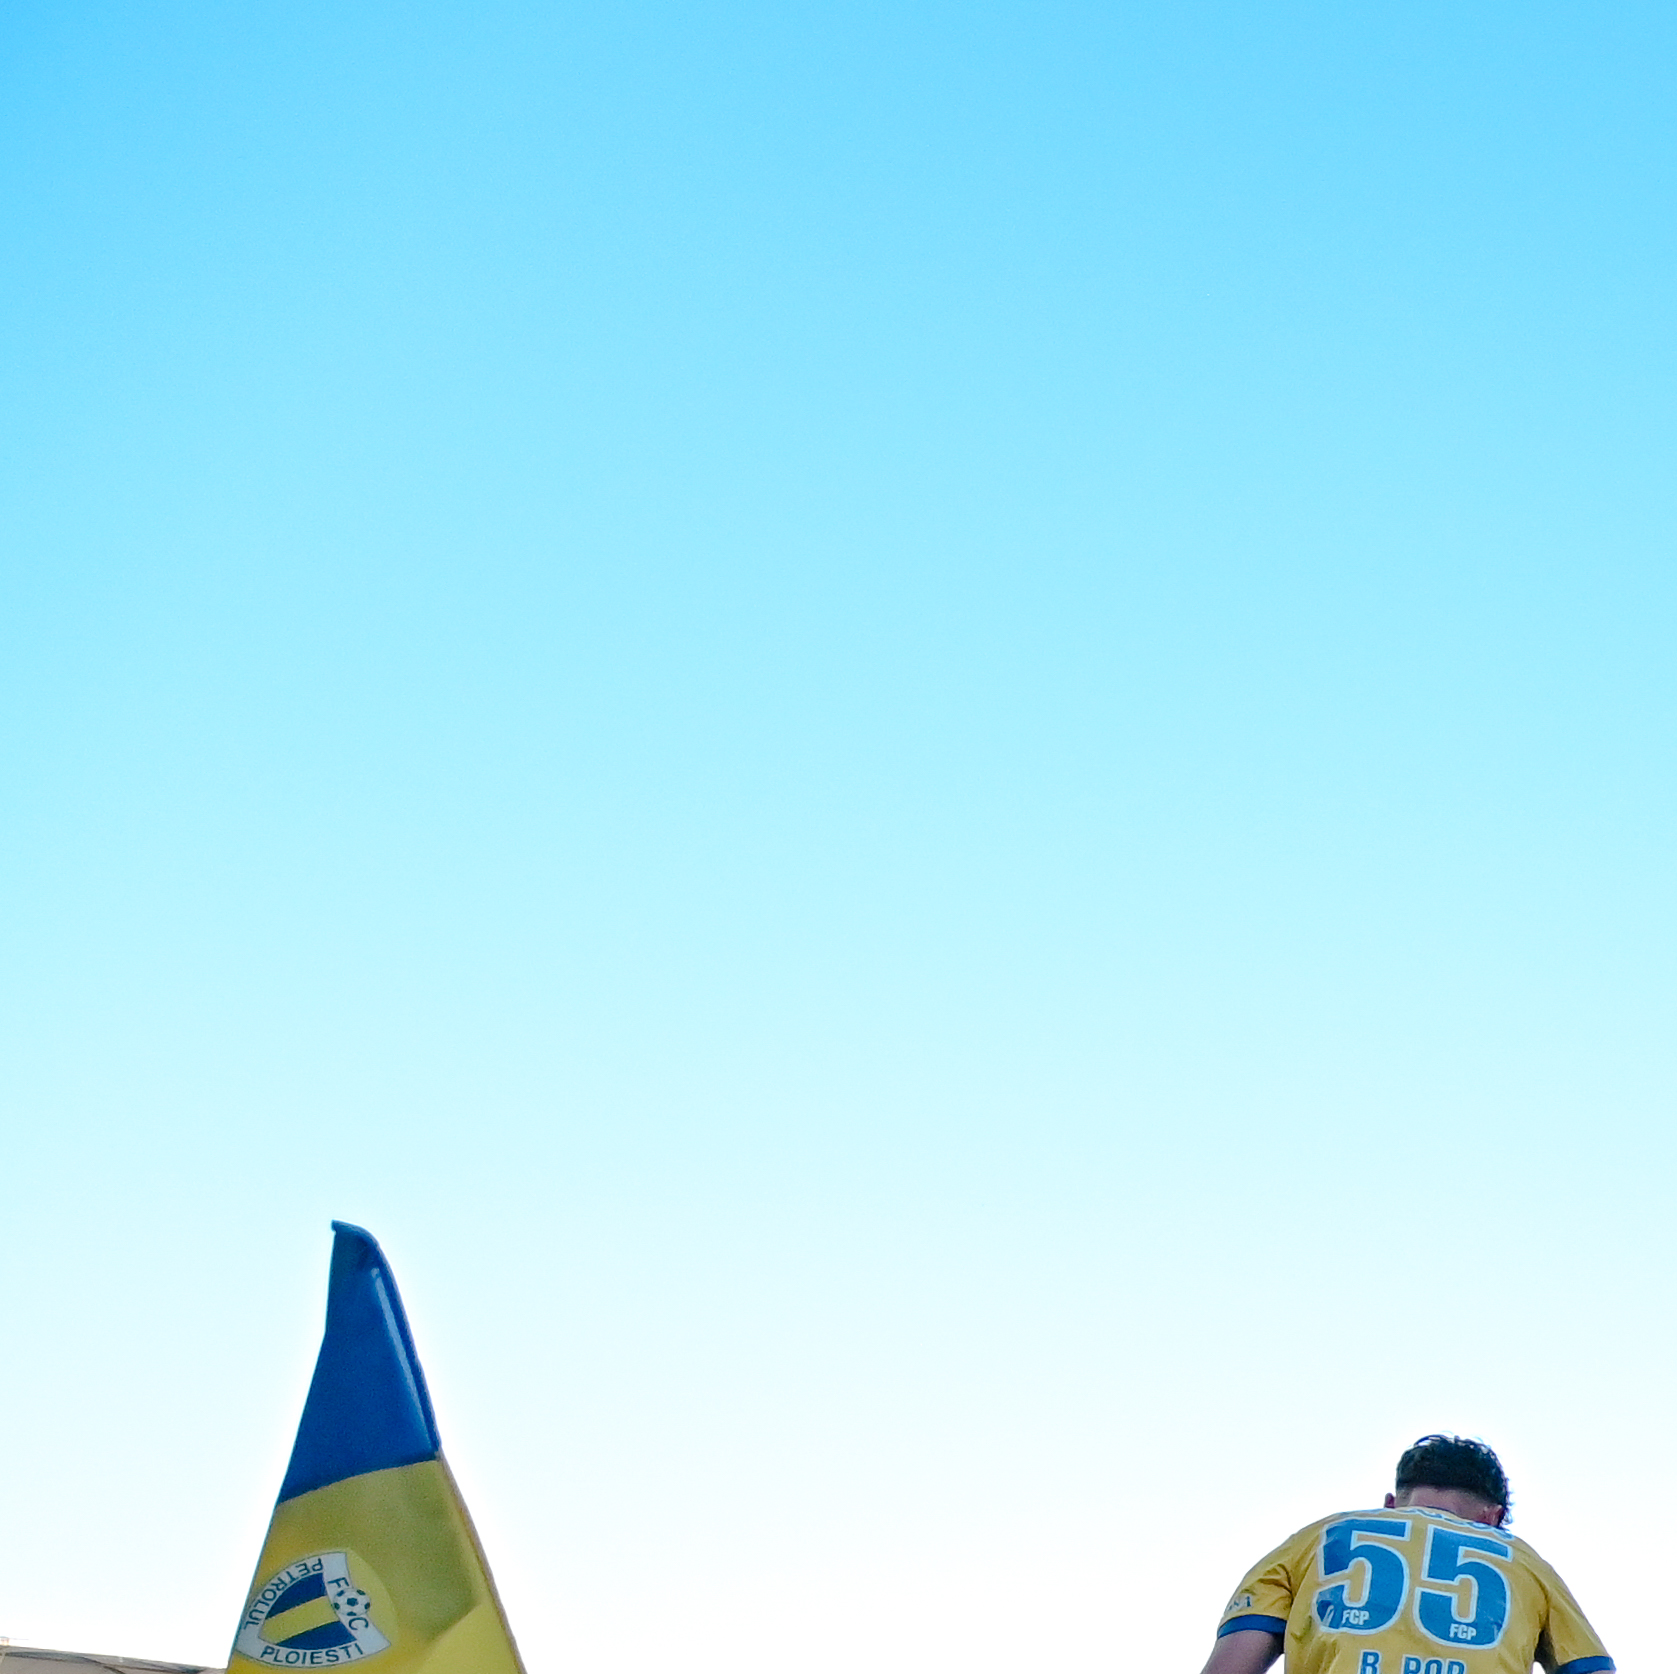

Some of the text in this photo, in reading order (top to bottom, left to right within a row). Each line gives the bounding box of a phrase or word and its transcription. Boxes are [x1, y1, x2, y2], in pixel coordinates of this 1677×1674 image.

[243, 1558, 323, 1630] PETROLUL
[1312, 1517, 1514, 1650] 55
[1342, 1609, 1370, 1626] FCP
[1450, 1623, 1477, 1640] FCP
[260, 1643, 363, 1666] PLOIESTI
